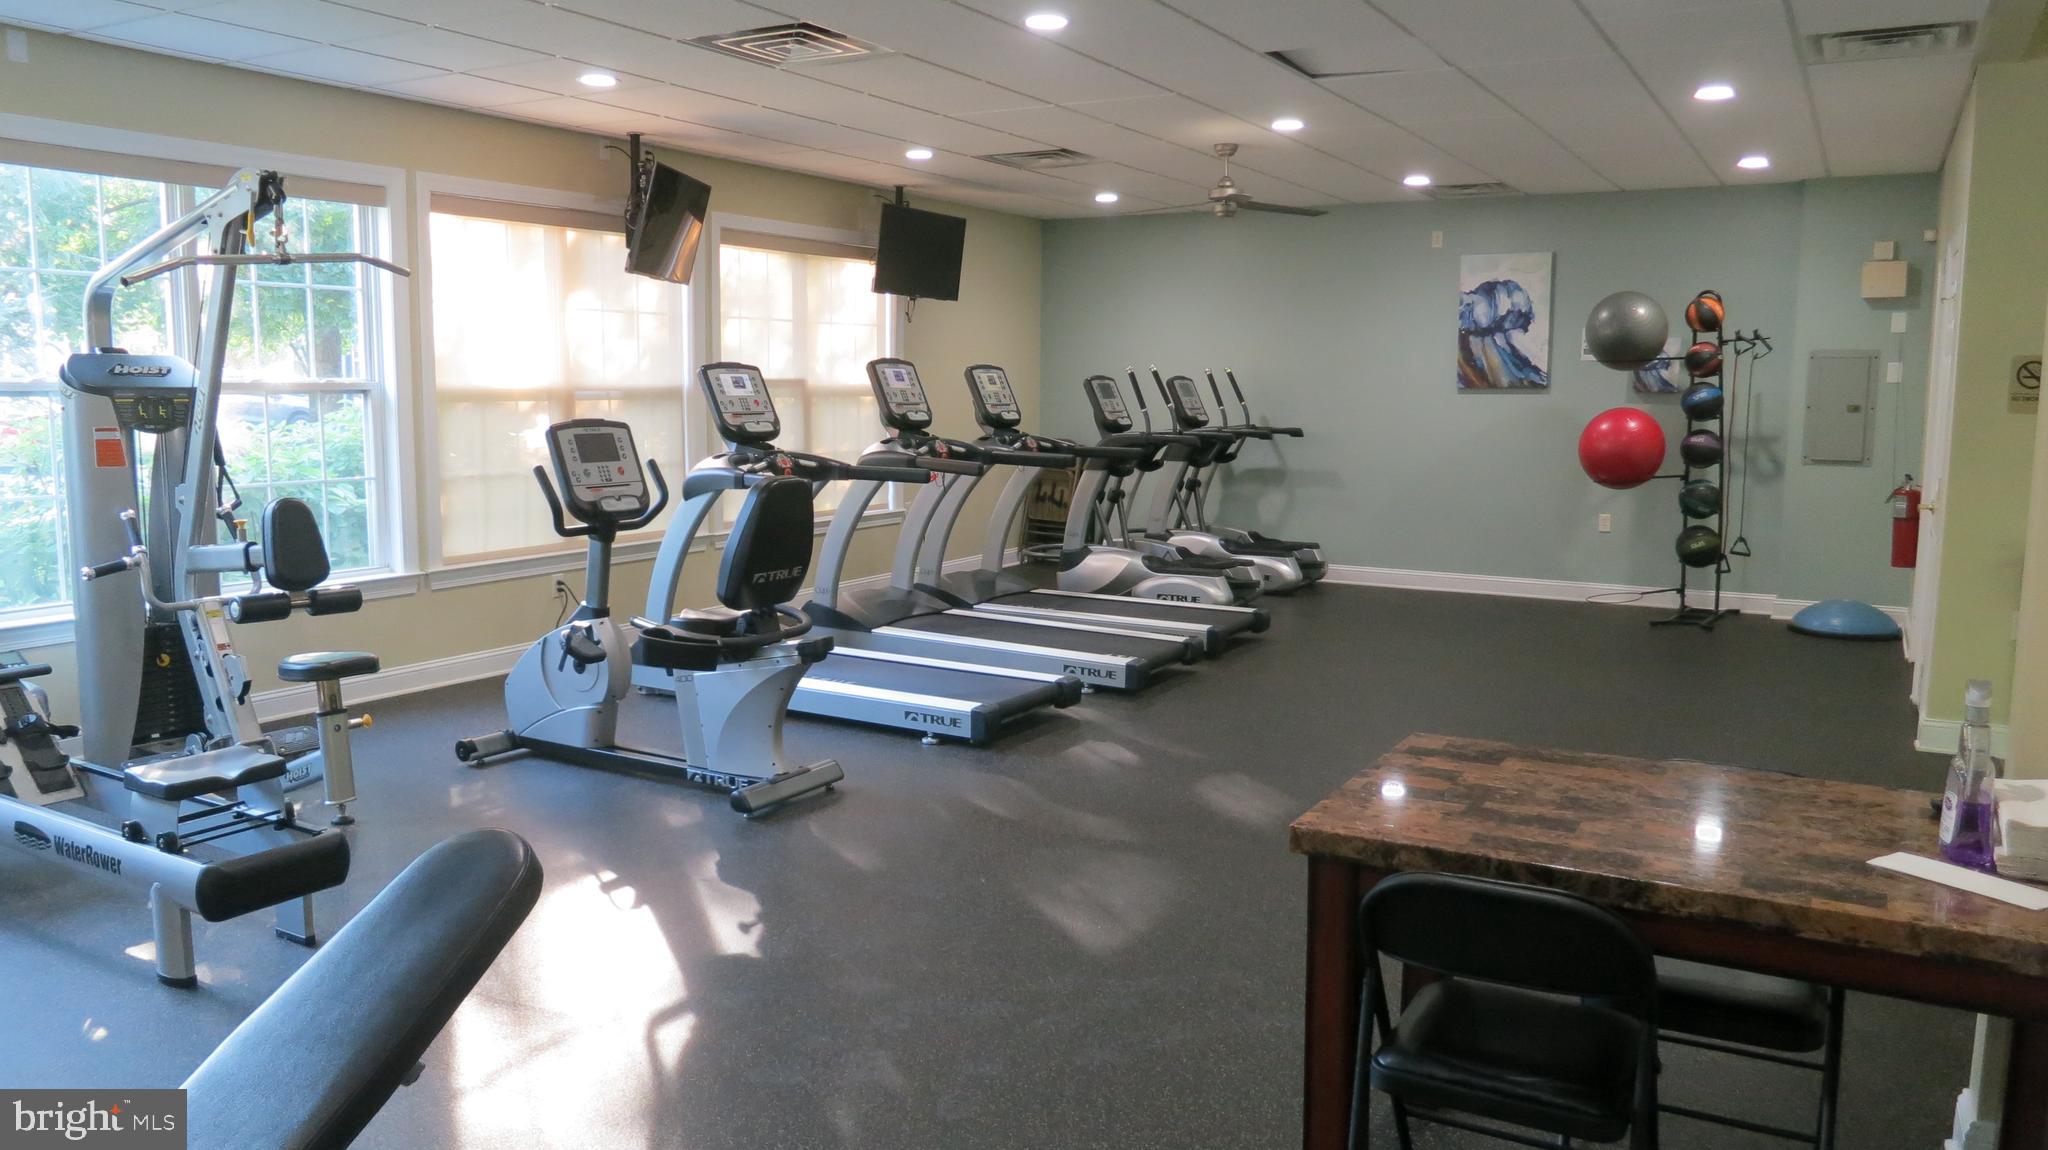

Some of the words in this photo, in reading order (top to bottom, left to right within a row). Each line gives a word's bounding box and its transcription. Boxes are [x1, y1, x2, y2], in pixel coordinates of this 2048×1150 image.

[113, 364, 171, 374] HOIST
[767, 566, 803, 581] TRUE
[1169, 594, 1201, 603] TRUE
[1078, 666, 1117, 680] TRUE
[920, 712, 962, 728] TRUE
[286, 763, 313, 781] HOIST
[702, 771, 749, 789] TRUE
[54, 835, 122, 875] WaterRower
